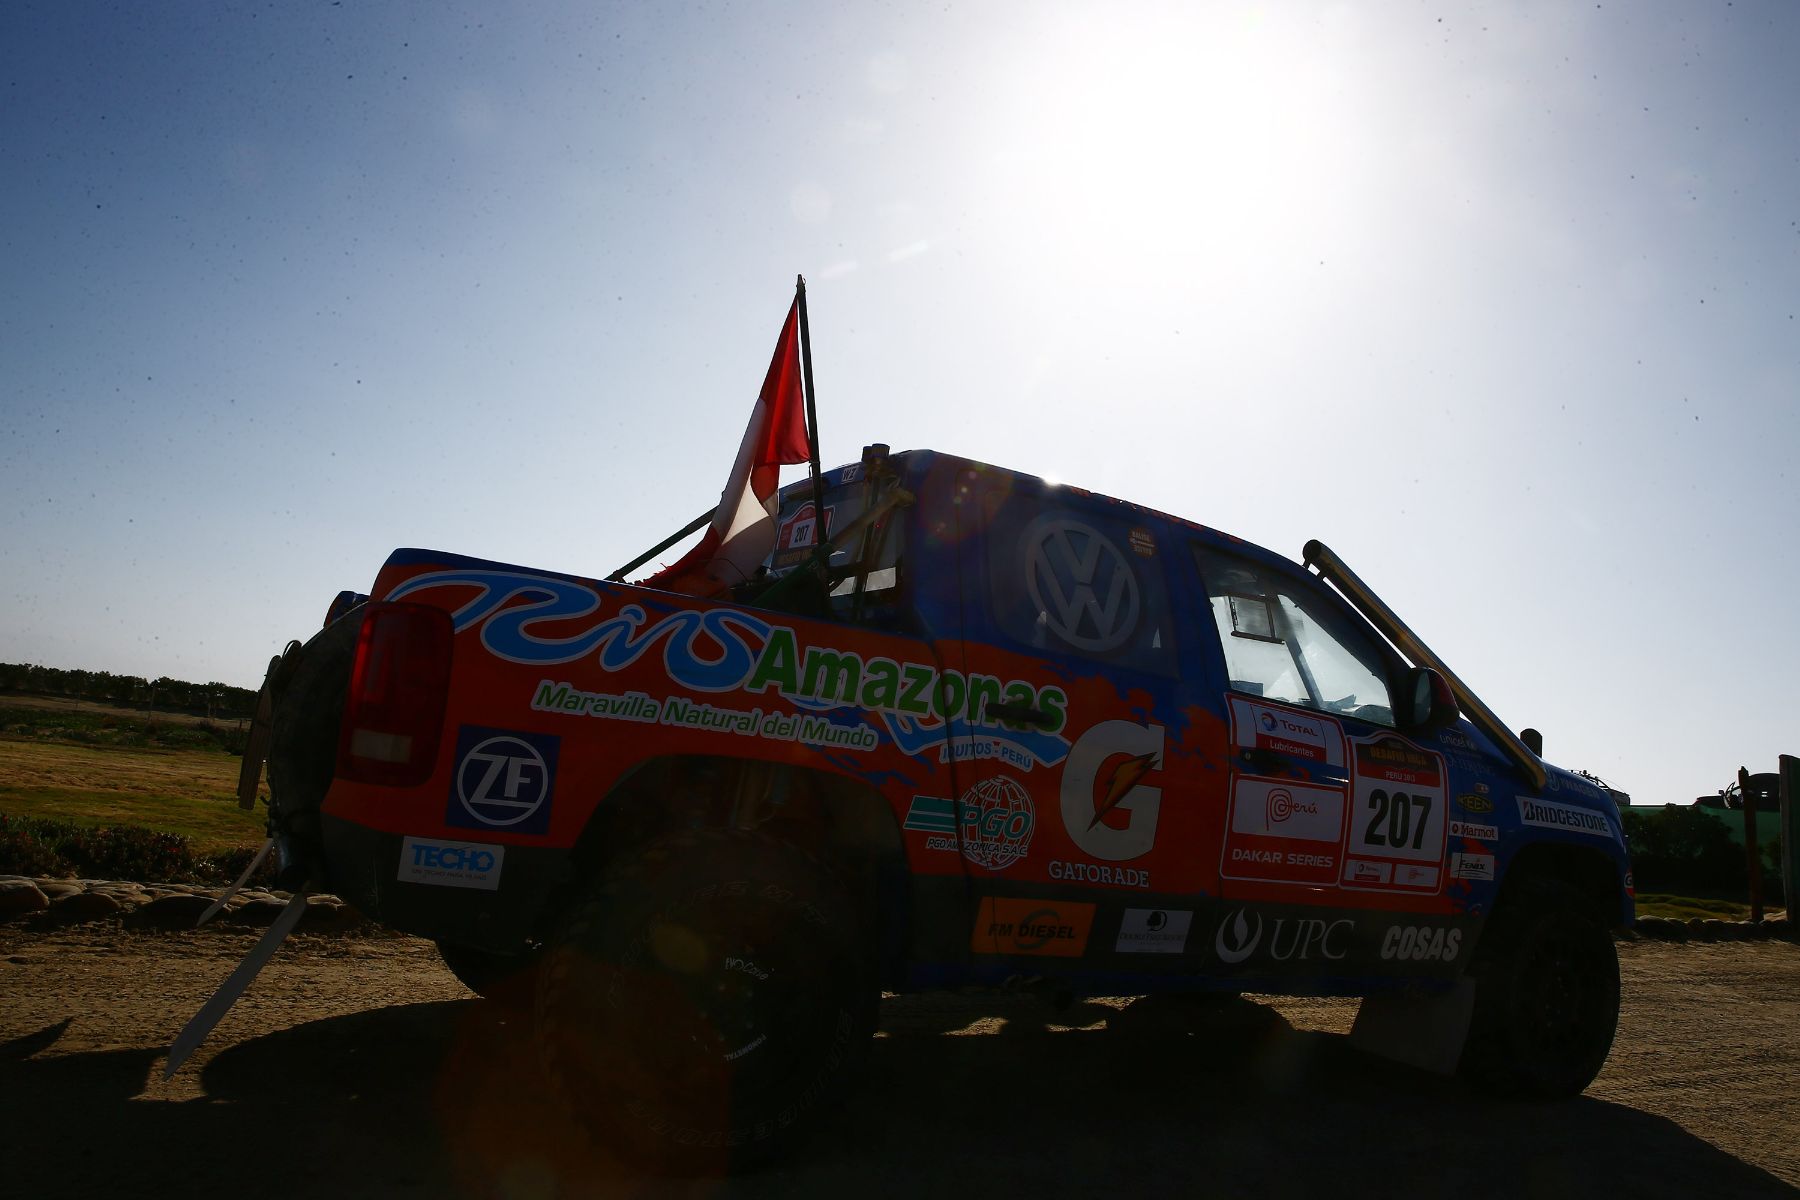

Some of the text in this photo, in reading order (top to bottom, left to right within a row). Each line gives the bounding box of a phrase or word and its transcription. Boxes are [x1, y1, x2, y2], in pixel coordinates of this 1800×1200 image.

[794, 525, 810, 543] 207
[747, 628, 1067, 735] Amazonas
[533, 682, 877, 749] Maravilla Natural del Mundo
[1280, 719, 1318, 737] TOTAL
[1000, 746, 1032, 768] PERÚ
[1269, 739, 1314, 758] Lubricantes
[466, 750, 545, 810] ZF
[1060, 719, 1166, 862] G
[959, 800, 1031, 839] PGO
[1363, 788, 1433, 850] 207
[1523, 799, 1609, 833] BRIDGESTONE
[1461, 823, 1495, 839] Marmot
[410, 843, 495, 872] TECHO
[947, 840, 999, 853] AMZONICA
[1231, 848, 1334, 869] DAKAR SERIES
[1048, 860, 1150, 888] GATORADE
[988, 922, 1076, 939] FM DIESEL
[1270, 918, 1356, 961] UPC
[1379, 924, 1463, 962] COSAS
